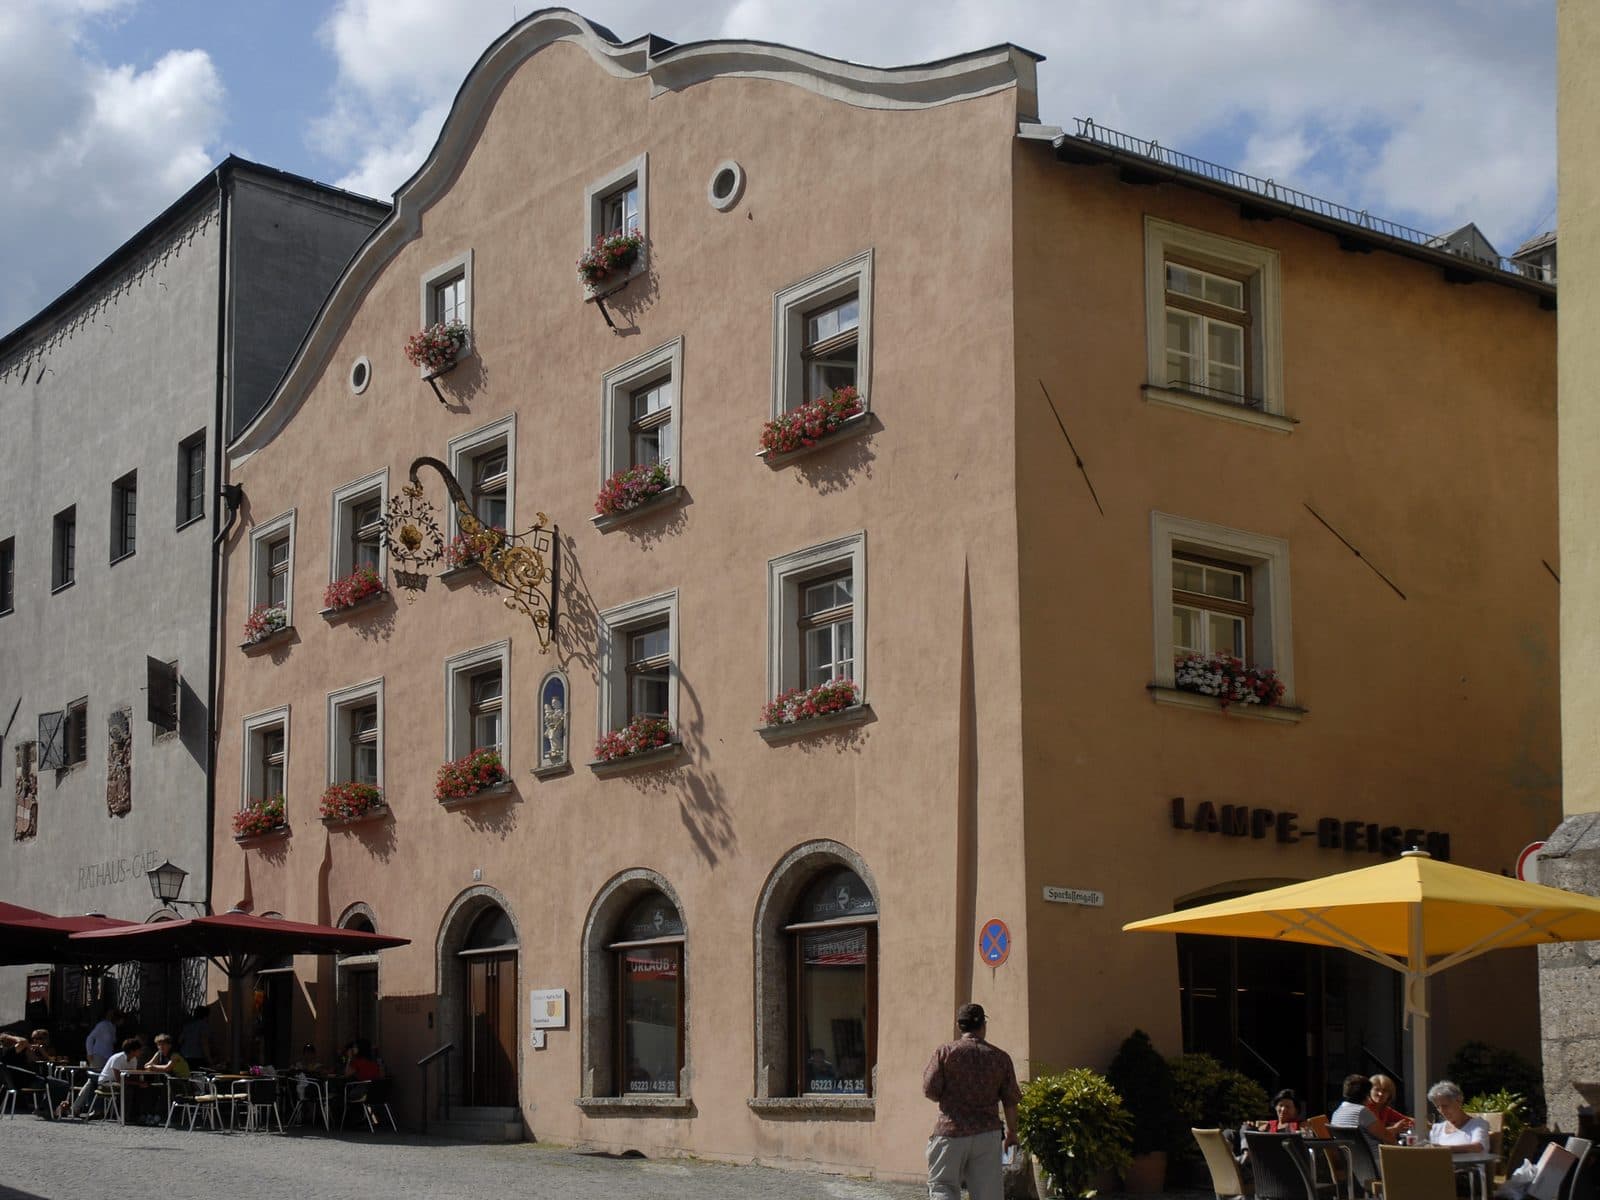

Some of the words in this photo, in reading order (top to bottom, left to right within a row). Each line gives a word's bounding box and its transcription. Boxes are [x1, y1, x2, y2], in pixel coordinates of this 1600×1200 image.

[1170, 796, 1450, 861] LAMPE-REISEN
[631, 957, 671, 973] URLAUB
[810, 1079, 833, 1091] 05223
[837, 1079, 843, 1090] 4
[843, 1079, 854, 1090] 25
[854, 1079, 865, 1091] 25
